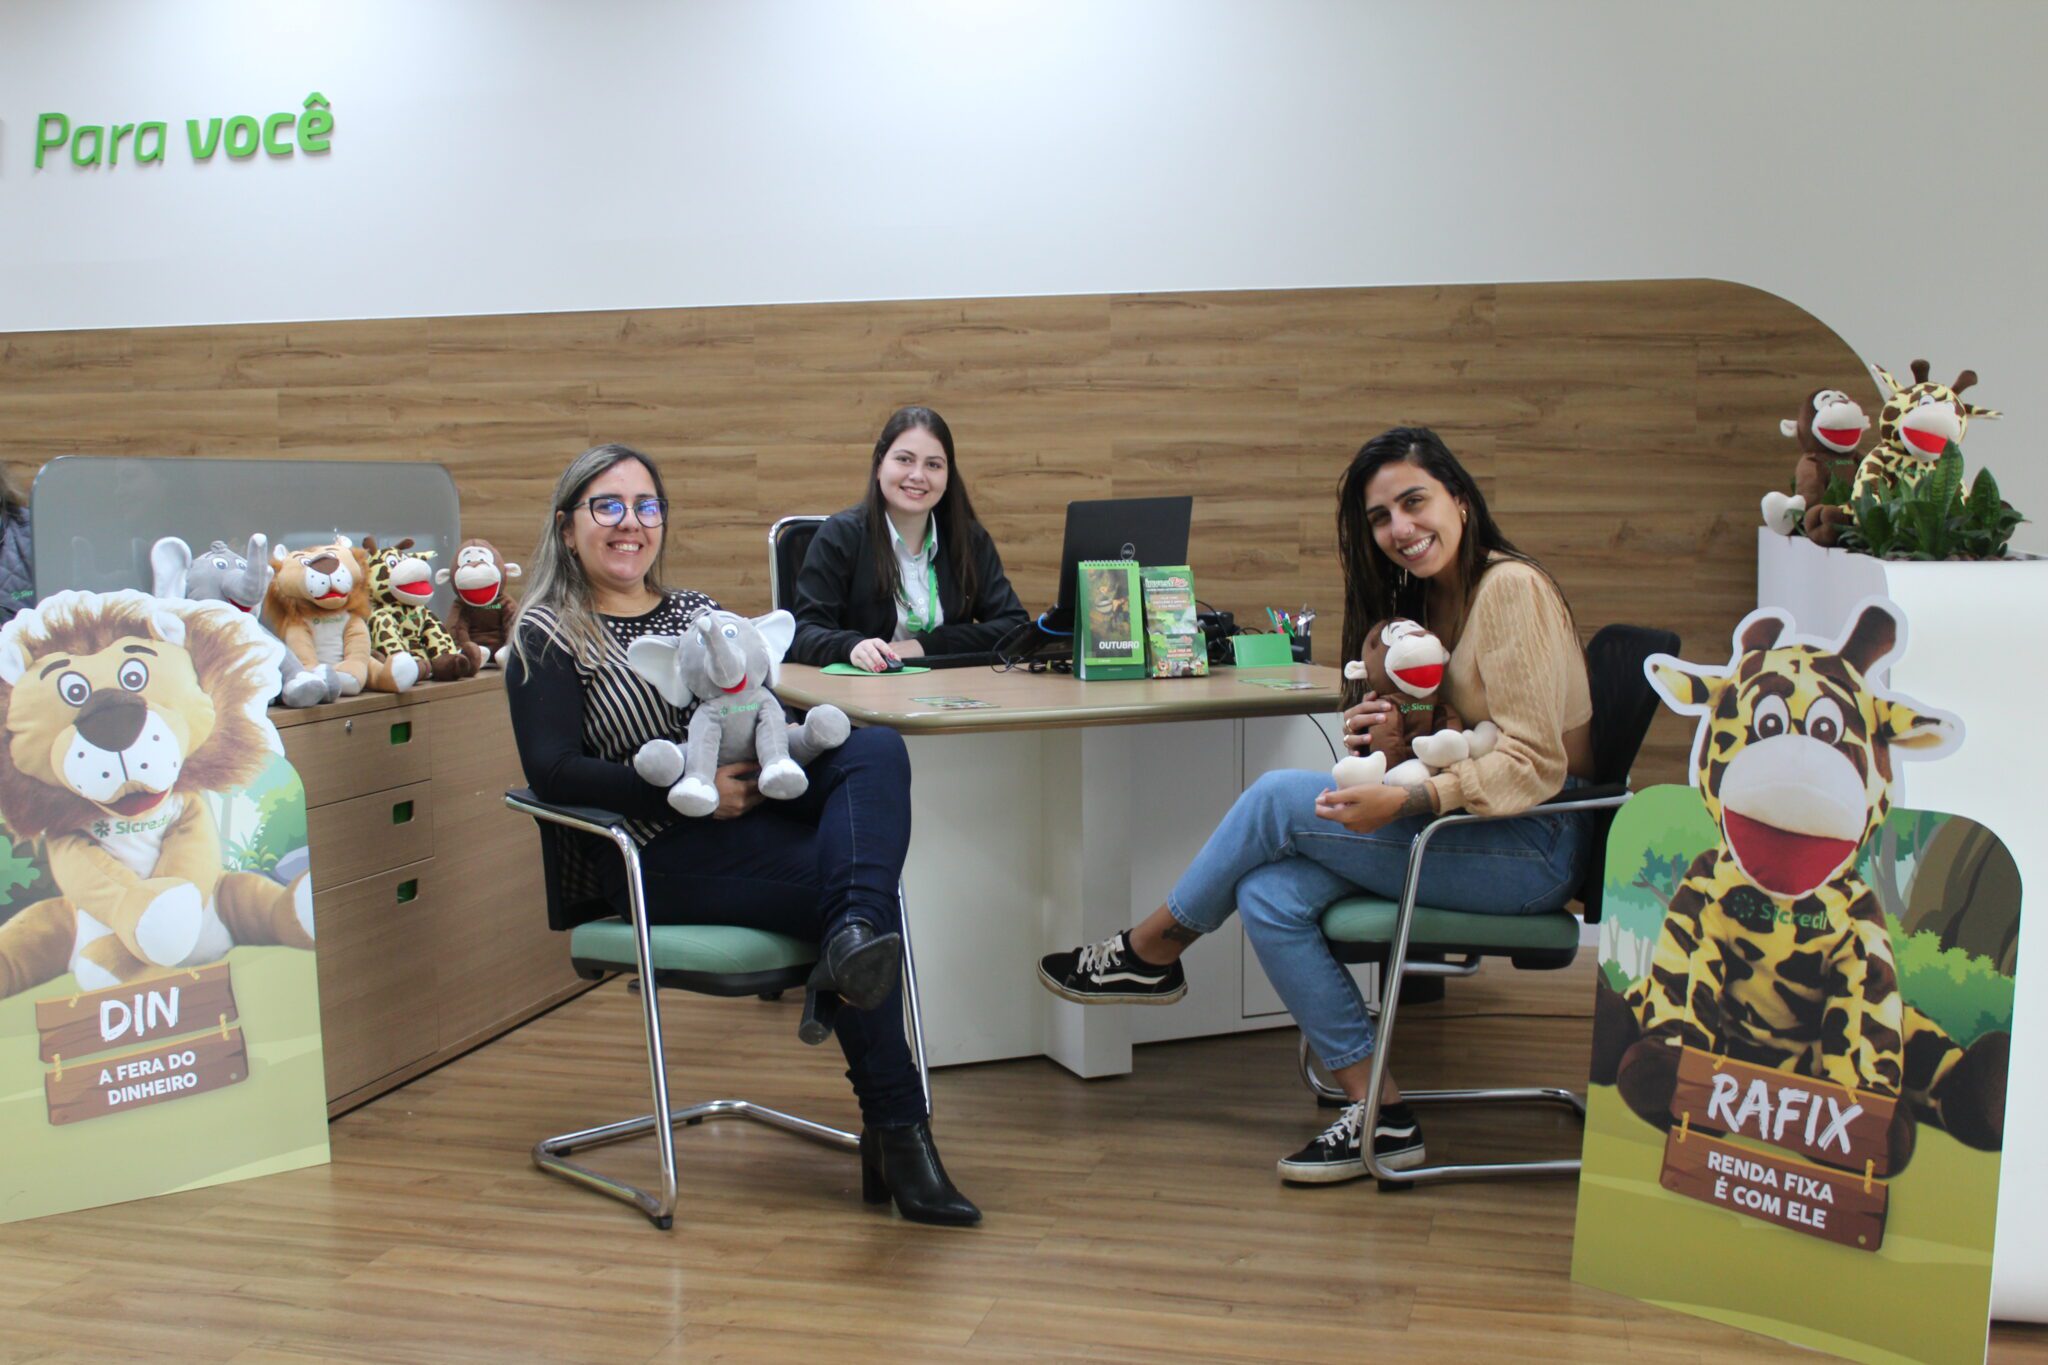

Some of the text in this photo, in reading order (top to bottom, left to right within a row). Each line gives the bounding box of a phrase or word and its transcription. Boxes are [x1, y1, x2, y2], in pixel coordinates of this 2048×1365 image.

[35, 92, 335, 169] Para você
[1099, 641, 1139, 649] OUTUBRO
[1411, 703, 1433, 711] Sicre
[1760, 903, 1828, 931] Sicredi
[100, 986, 180, 1042] DIN
[98, 1050, 196, 1086] A FERA DO
[107, 1072, 198, 1106] DINHEIRO
[1707, 1073, 1864, 1155] RAFIX
[1707, 1150, 1834, 1205] RENDA FIXA
[1714, 1176, 1828, 1229] É COM ELE
